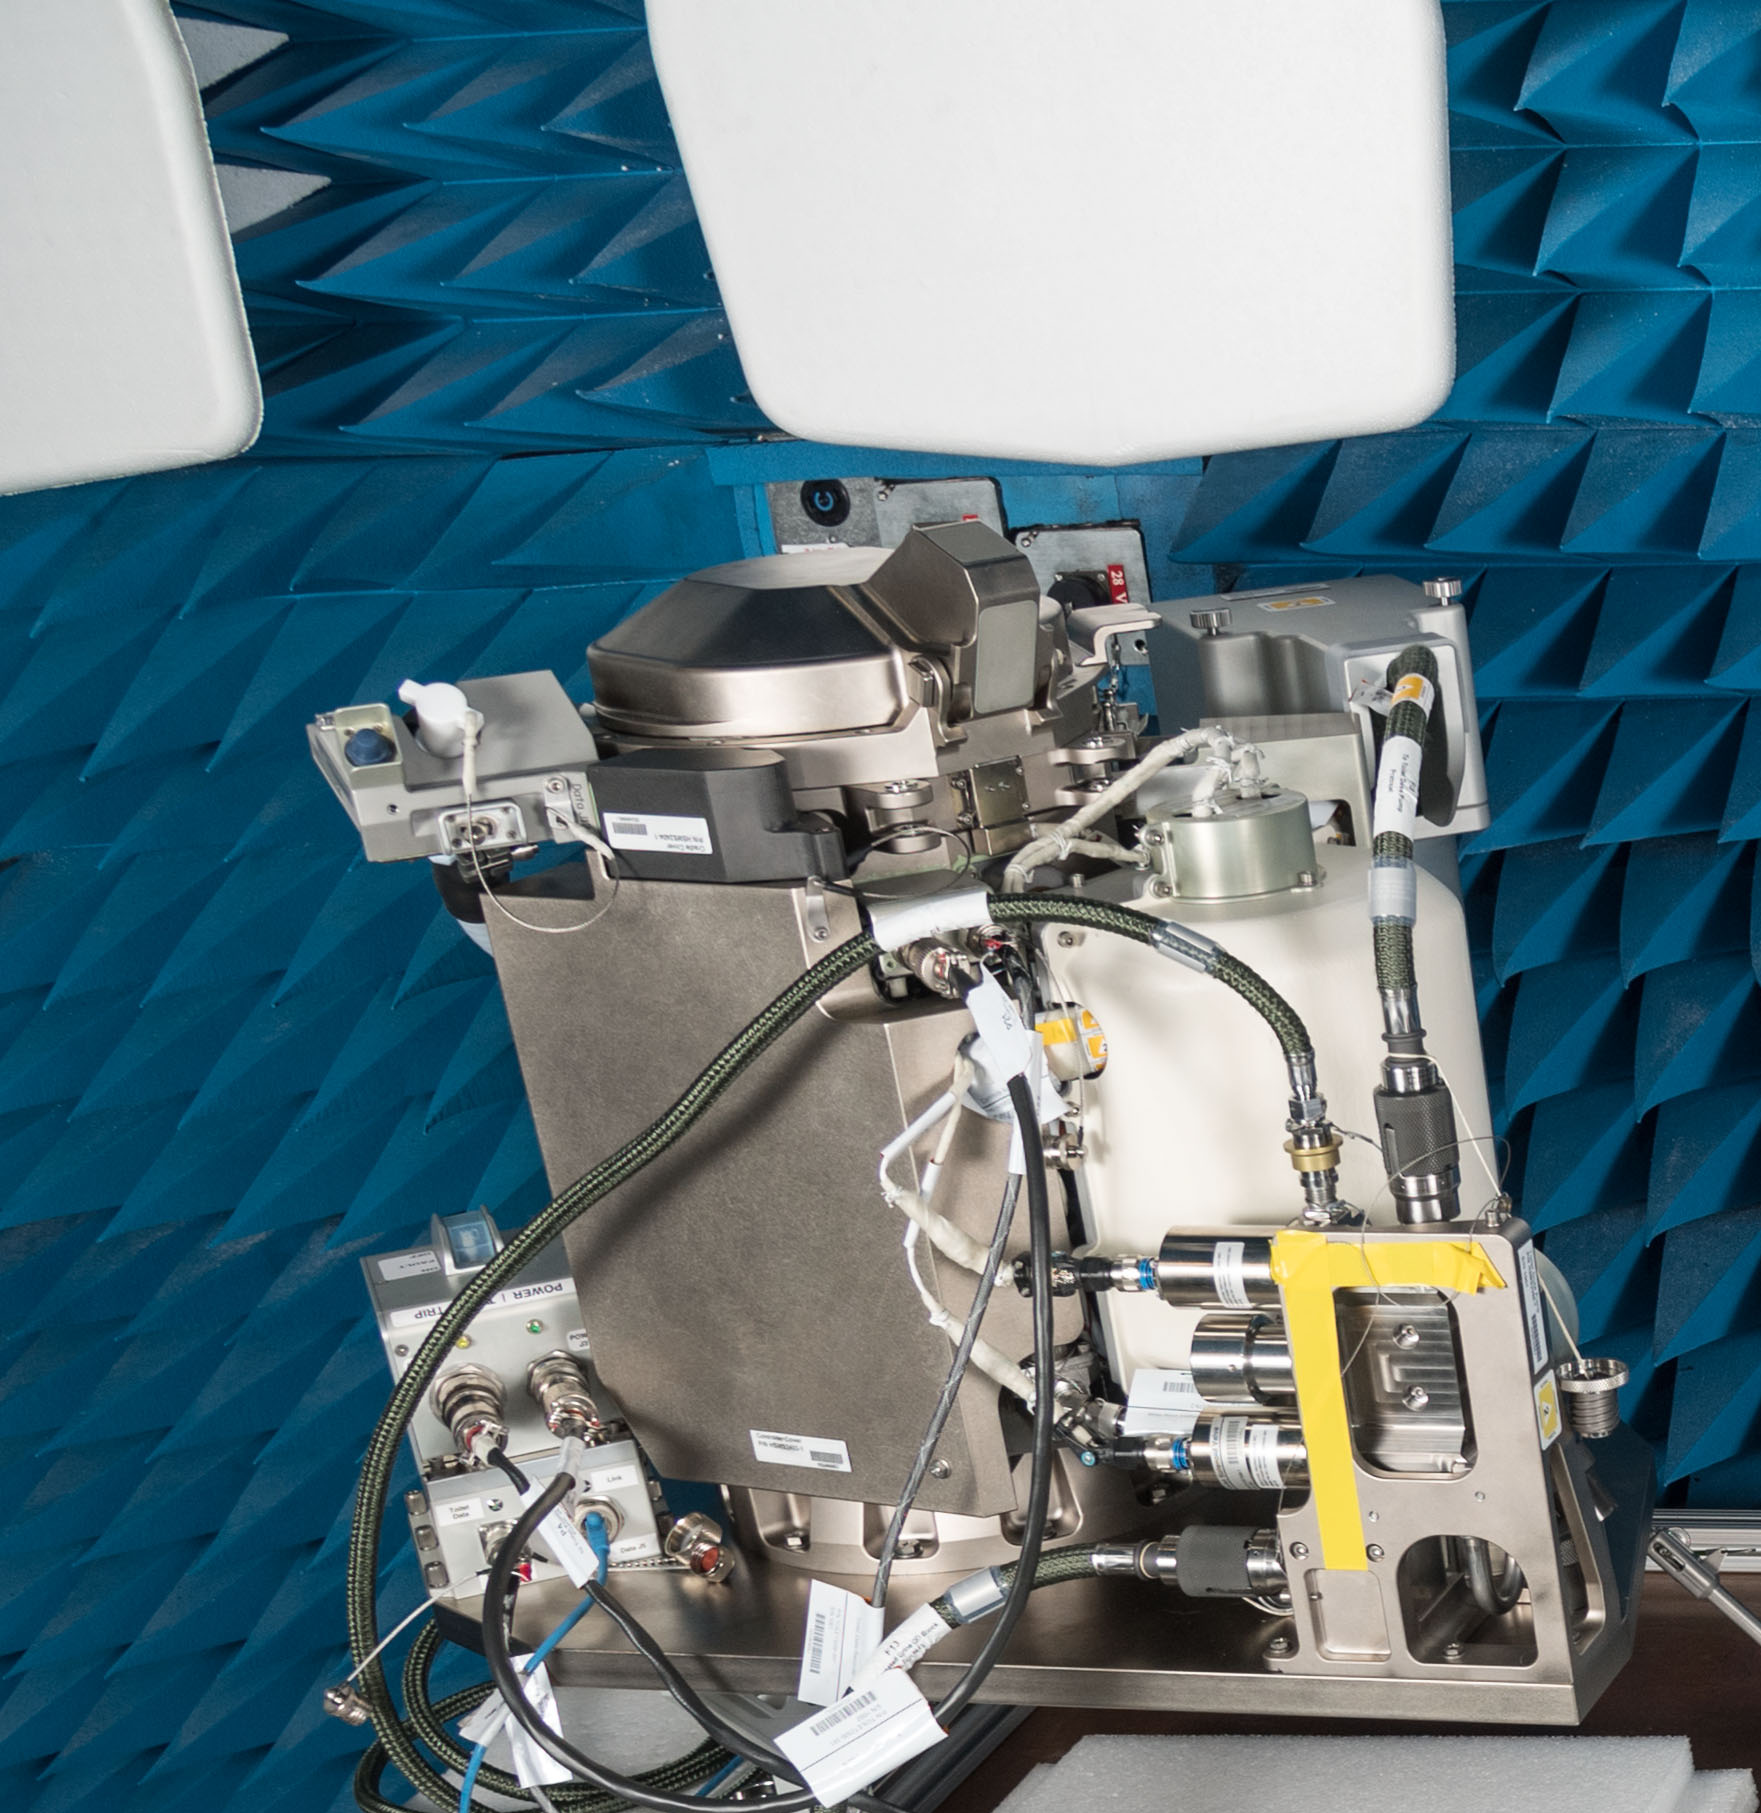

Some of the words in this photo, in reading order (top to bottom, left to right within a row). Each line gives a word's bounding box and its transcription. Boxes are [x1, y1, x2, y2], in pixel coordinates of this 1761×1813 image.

[1111, 570, 1125, 586] 28
[513, 1282, 564, 1300] POWER
[414, 1306, 444, 1320] TRIP
[452, 1511, 469, 1519] Data
[620, 1545, 637, 1554] Data
